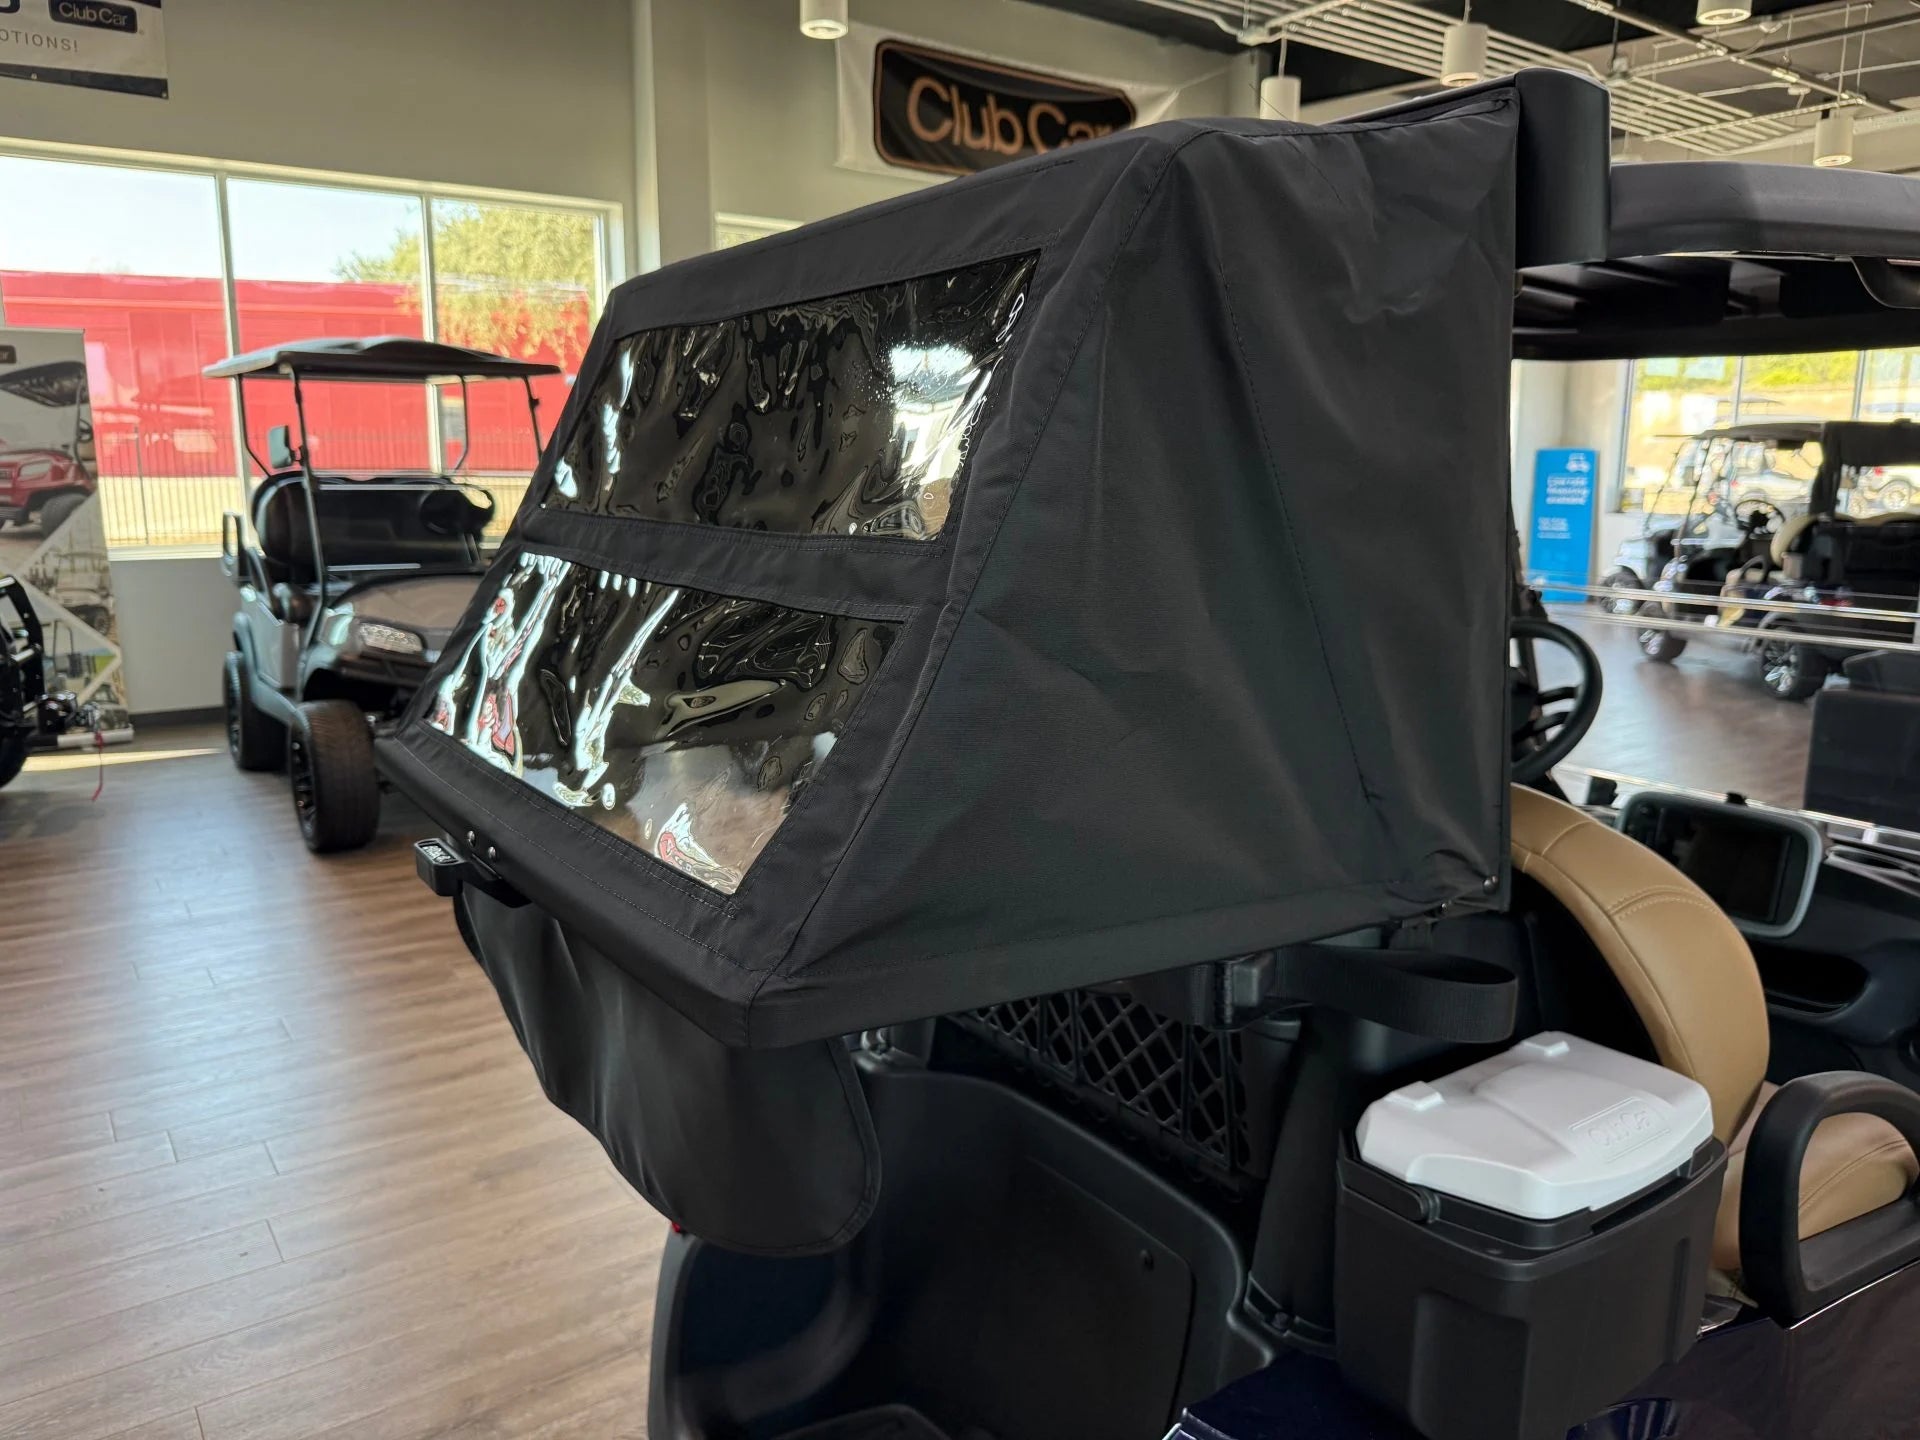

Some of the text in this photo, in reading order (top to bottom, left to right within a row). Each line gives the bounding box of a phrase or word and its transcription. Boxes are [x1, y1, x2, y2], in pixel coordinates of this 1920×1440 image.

[59, 2, 128, 26] Club Car
[907, 76, 1024, 155] Club
